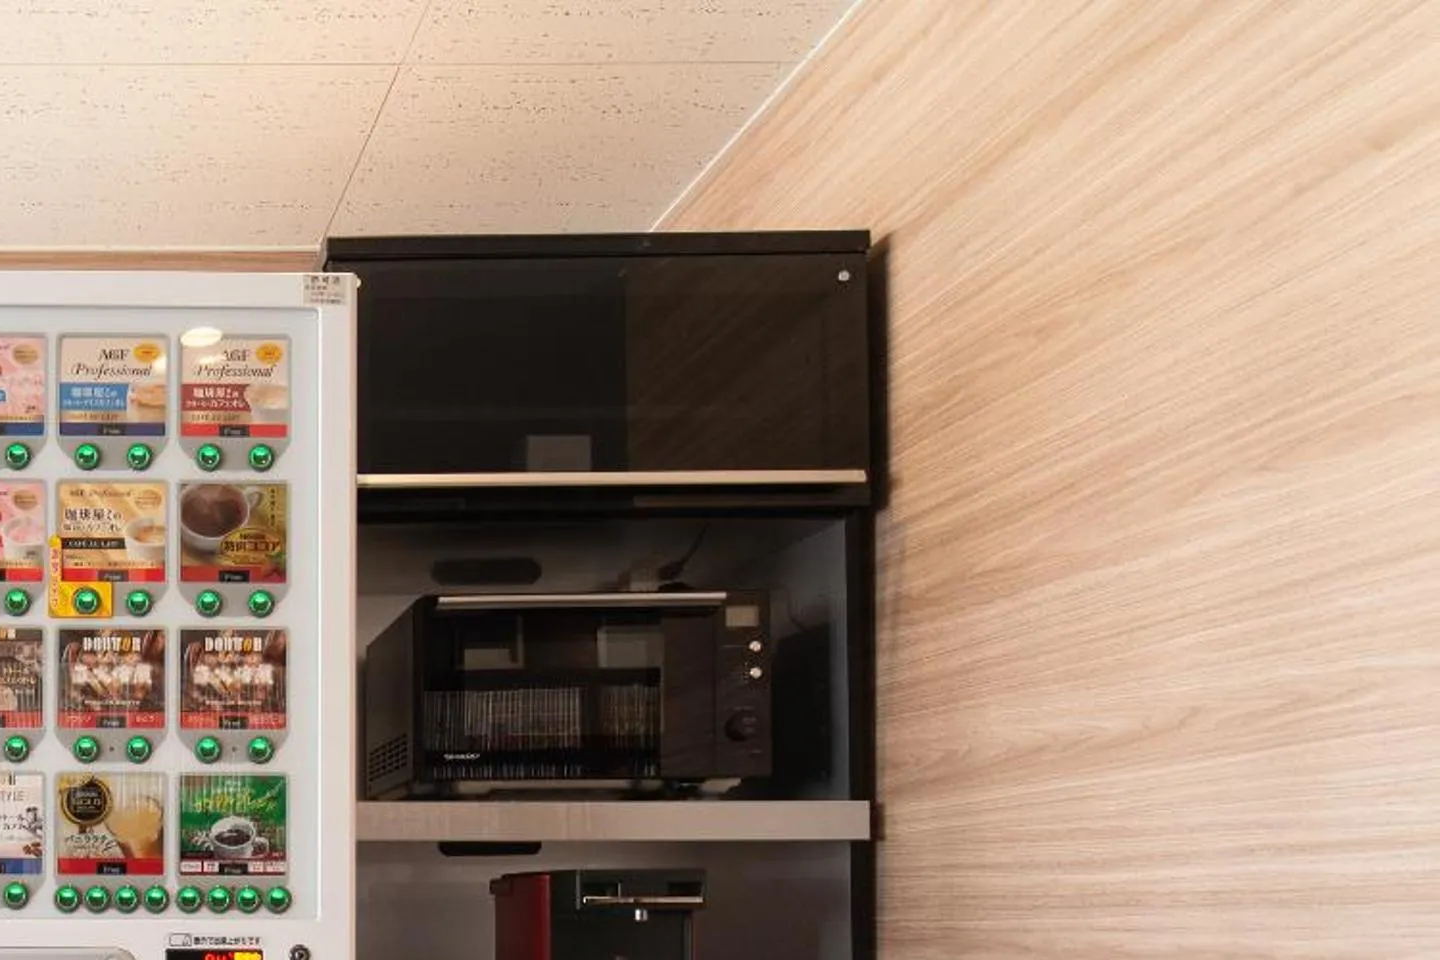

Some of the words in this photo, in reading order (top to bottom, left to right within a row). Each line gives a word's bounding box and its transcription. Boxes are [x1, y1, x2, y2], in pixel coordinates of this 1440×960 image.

[98, 347, 131, 361] AGF
[71, 363, 153, 381] Professional
[196, 363, 274, 381] Professional
[83, 636, 141, 653] DOUTOR
[204, 636, 262, 653] DOUTOR
